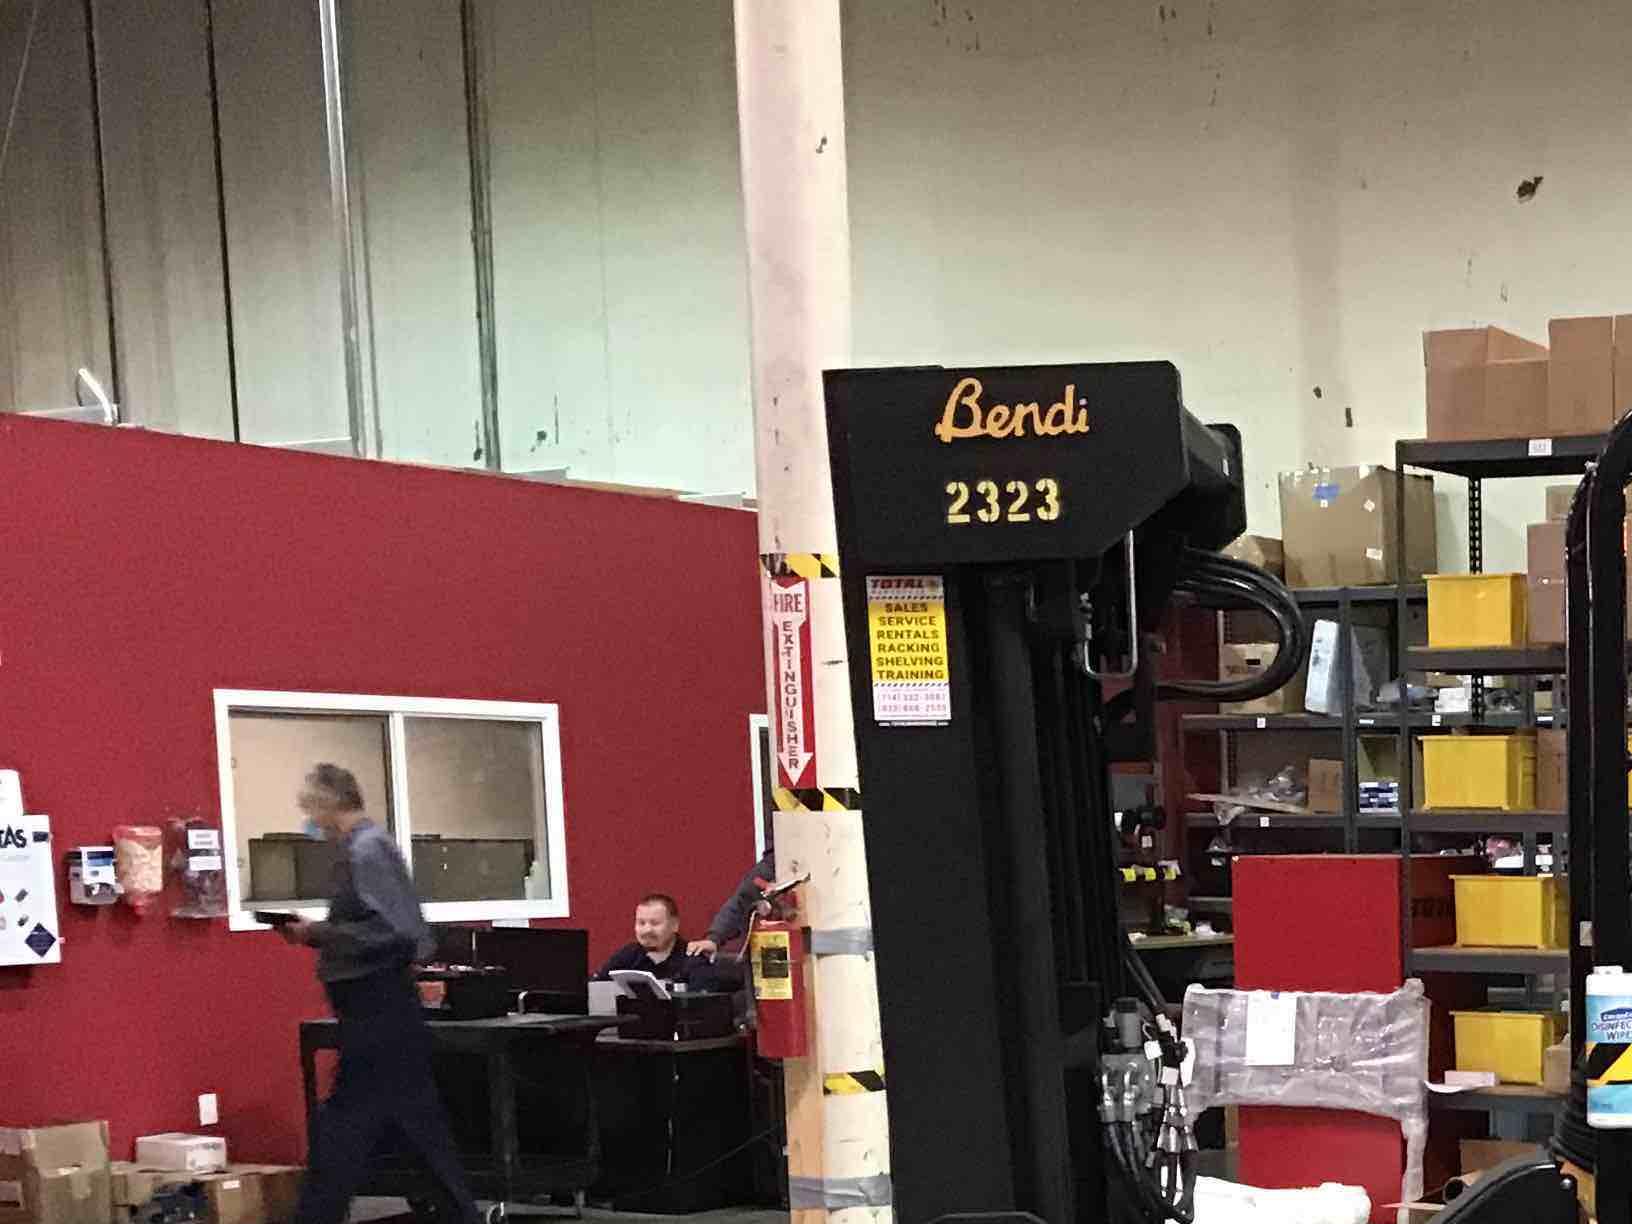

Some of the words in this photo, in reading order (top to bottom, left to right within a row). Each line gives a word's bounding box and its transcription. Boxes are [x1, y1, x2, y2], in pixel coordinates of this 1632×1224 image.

[934, 377, 1090, 443] Bendi
[945, 478, 1061, 523] 2323
[774, 593, 803, 614] FIRE
[885, 602, 928, 613] SALES
[878, 615, 937, 626] SERVICE
[876, 629, 939, 640] RENTALS
[877, 643, 940, 653] RACKING
[876, 656, 944, 667] SHELVING
[876, 670, 945, 680] TRAINING
[782, 620, 799, 770] EXTINGUISHER
